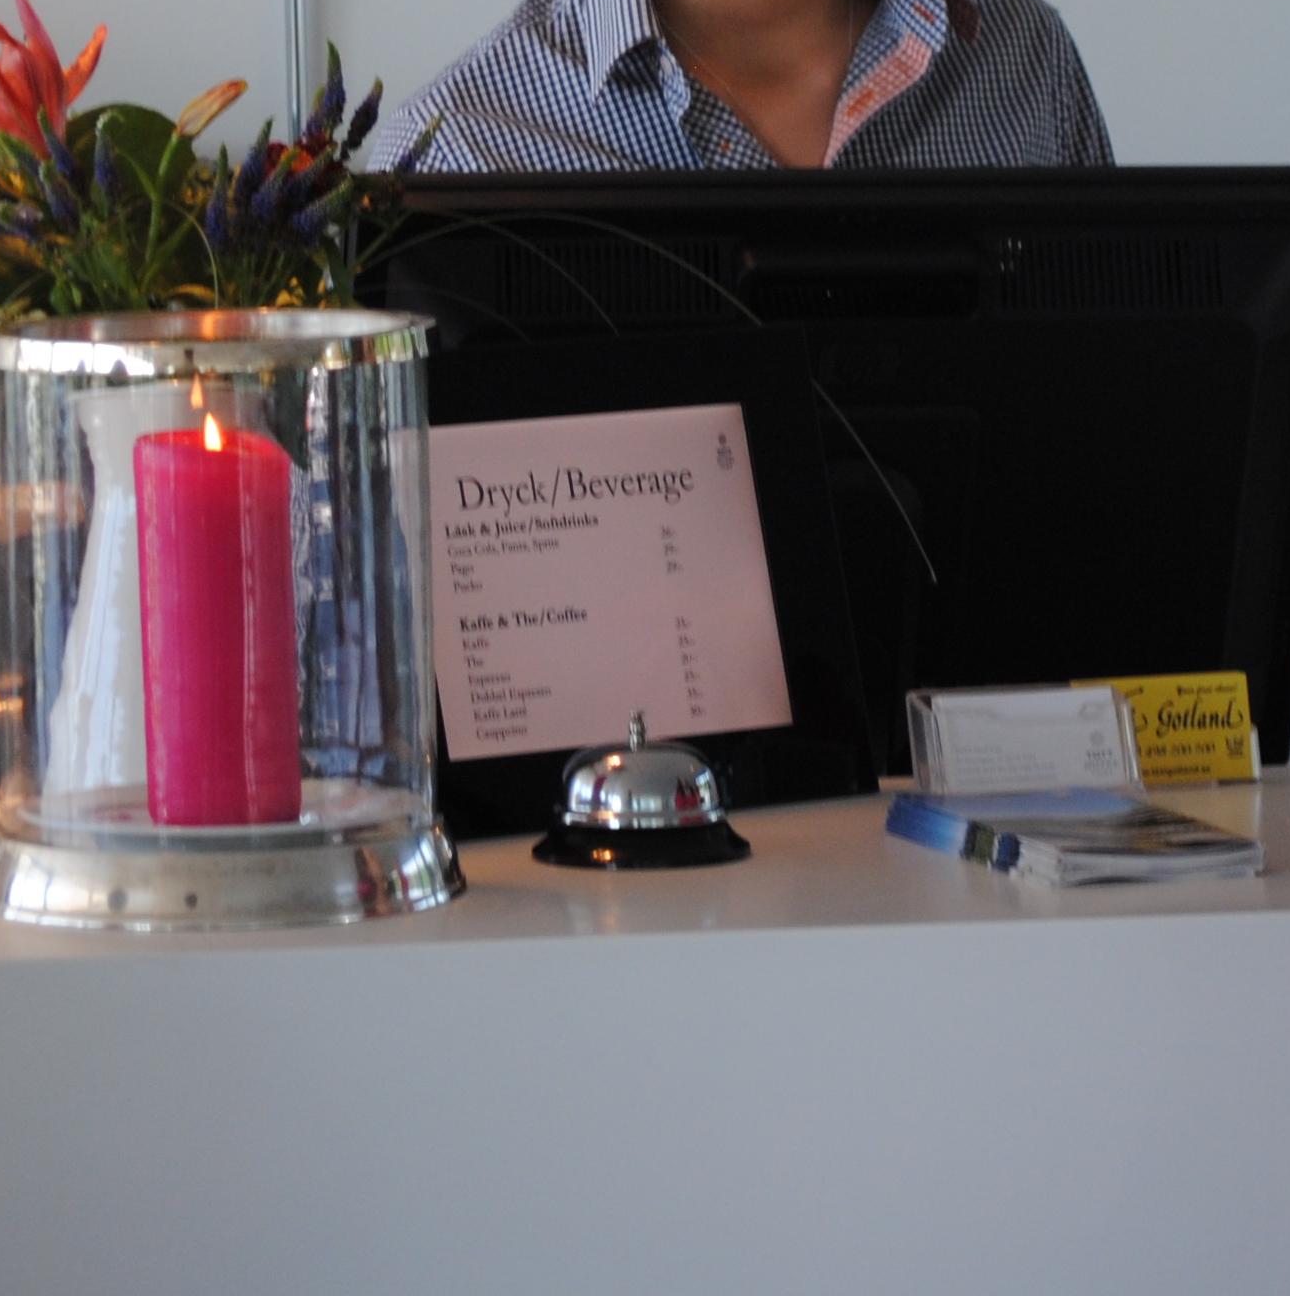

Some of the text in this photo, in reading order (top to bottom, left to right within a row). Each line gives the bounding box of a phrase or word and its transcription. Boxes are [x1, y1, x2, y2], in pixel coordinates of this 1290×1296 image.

[456, 465, 694, 518] Dryck/Beverage
[480, 522, 492, 537] &
[459, 606, 588, 633] Kaffe & The/Coffee
[1156, 696, 1244, 738] Gotland
